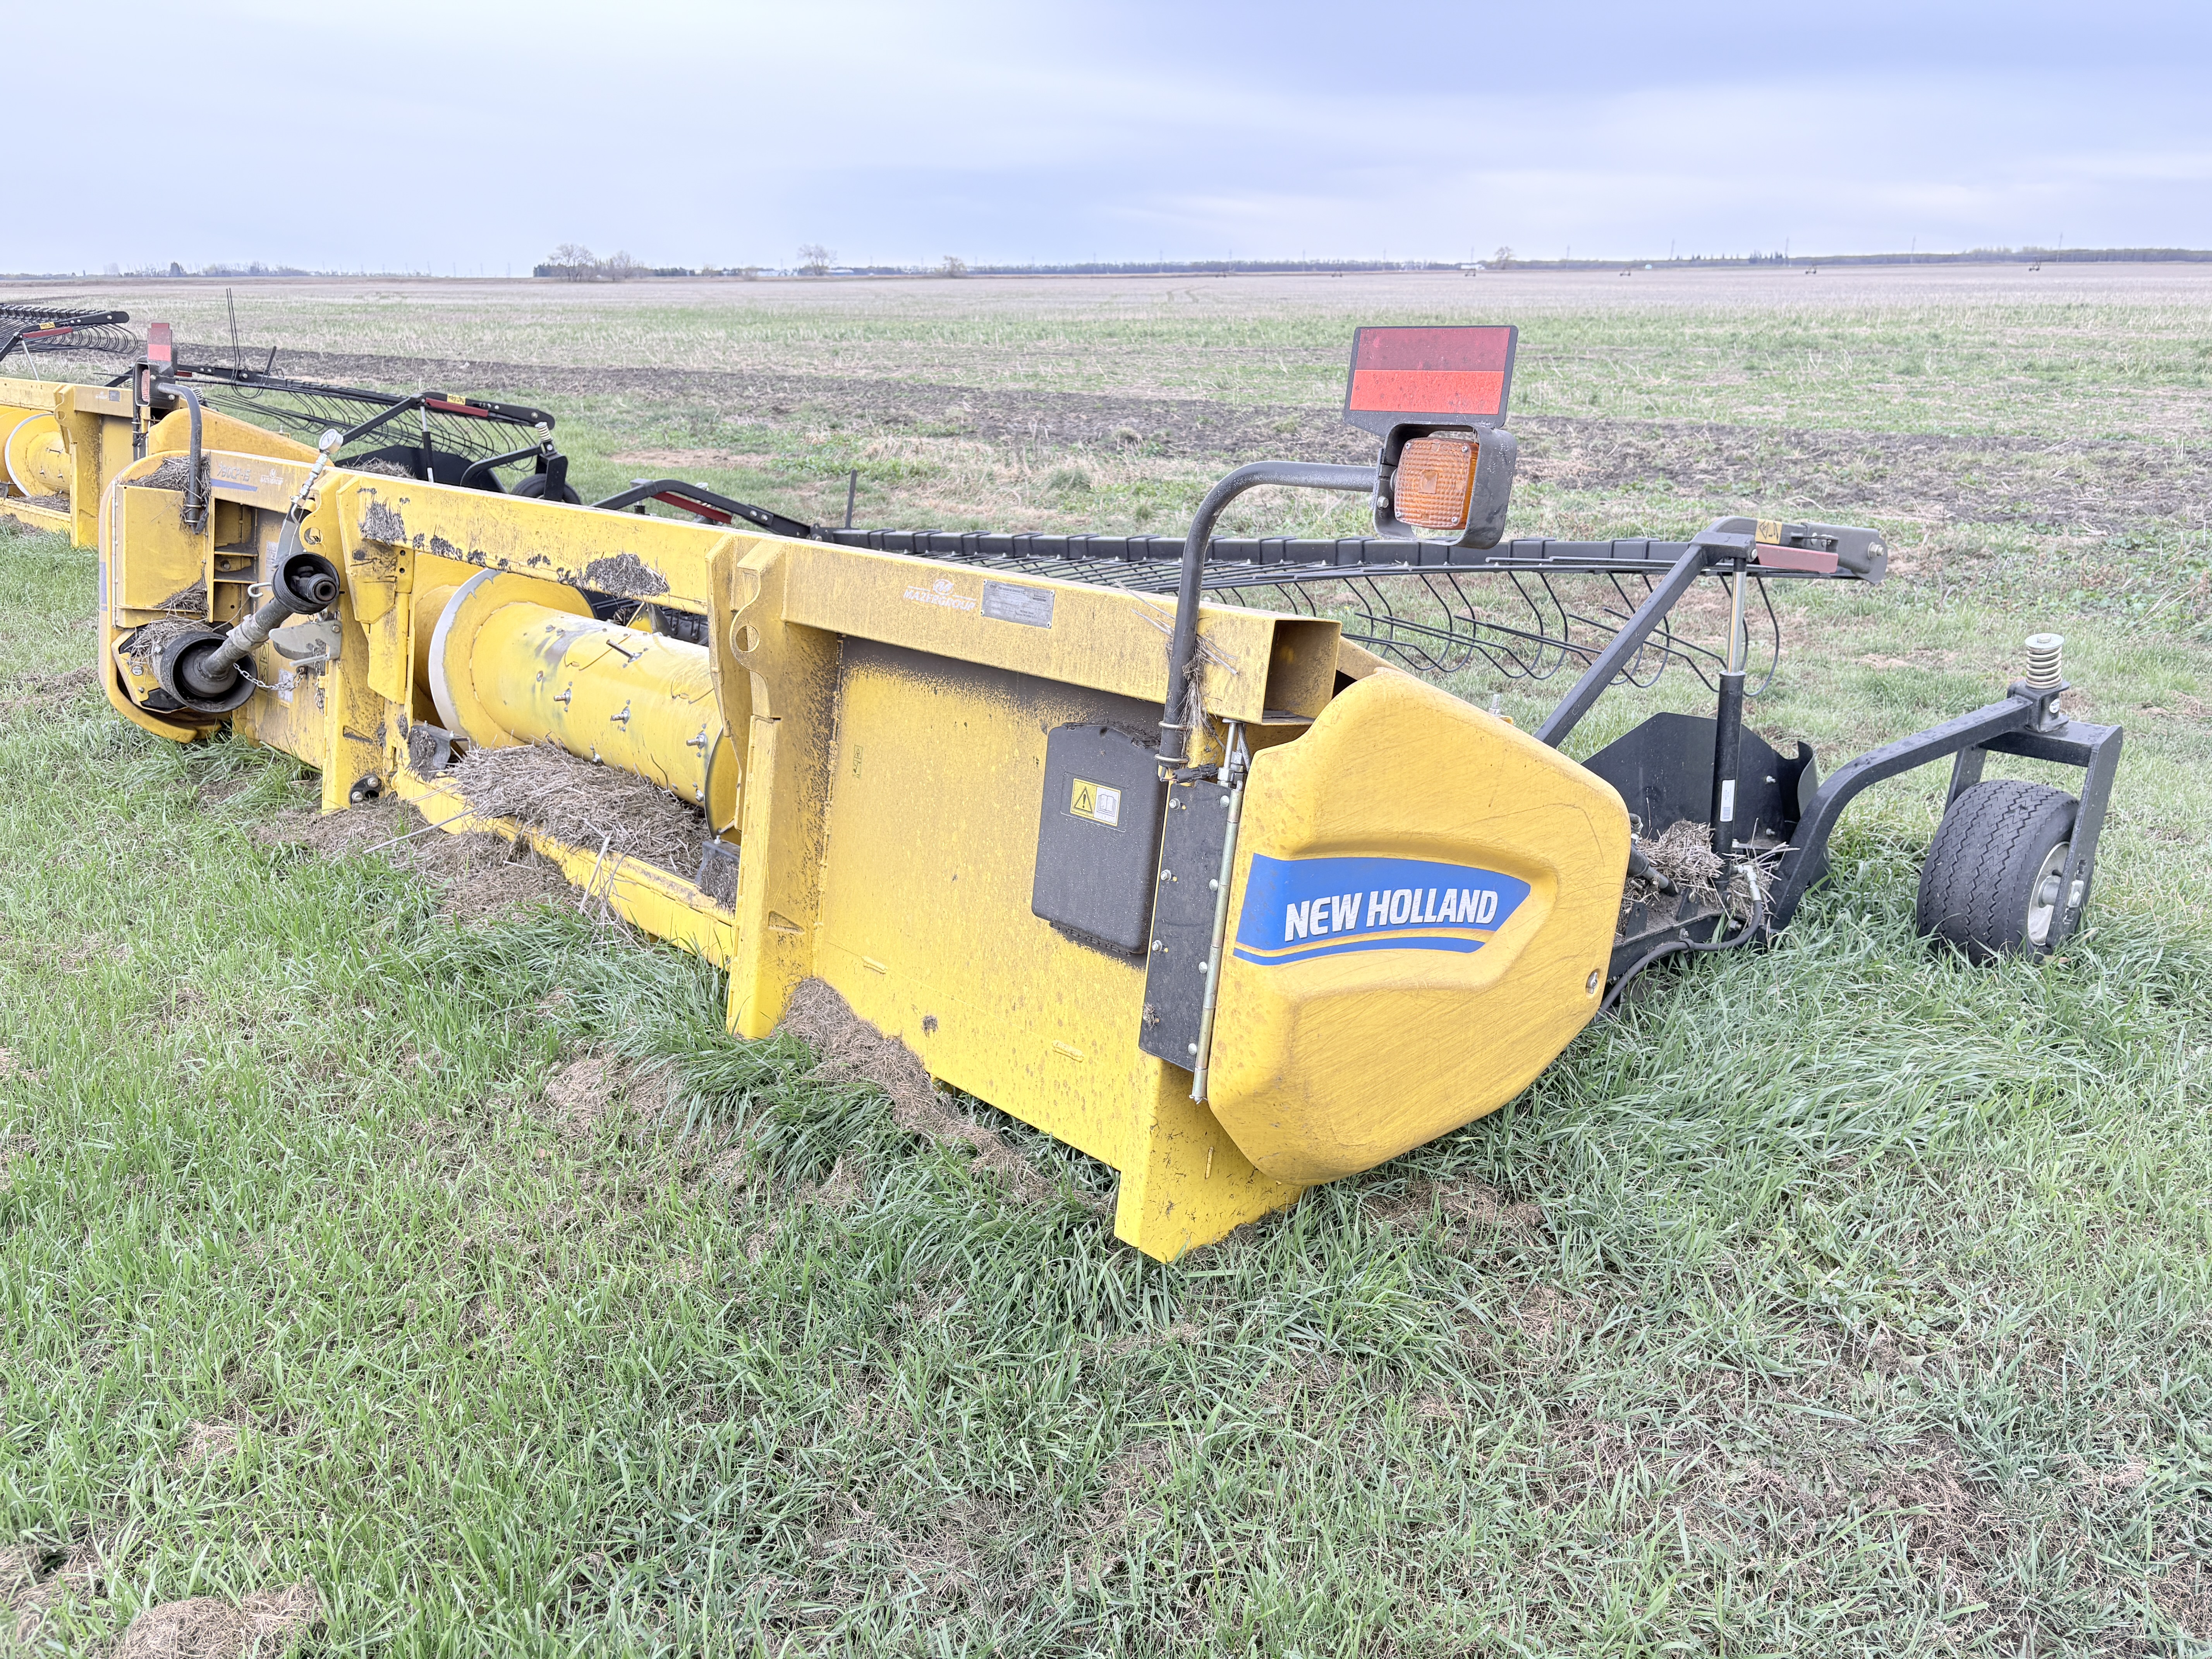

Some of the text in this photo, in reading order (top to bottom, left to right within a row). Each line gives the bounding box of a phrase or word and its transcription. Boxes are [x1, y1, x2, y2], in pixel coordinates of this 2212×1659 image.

[217, 464, 251, 482] 790CP-15
[903, 589, 975, 611] MAZERGROUP
[1285, 888, 1498, 942] NEW HOLLAND
